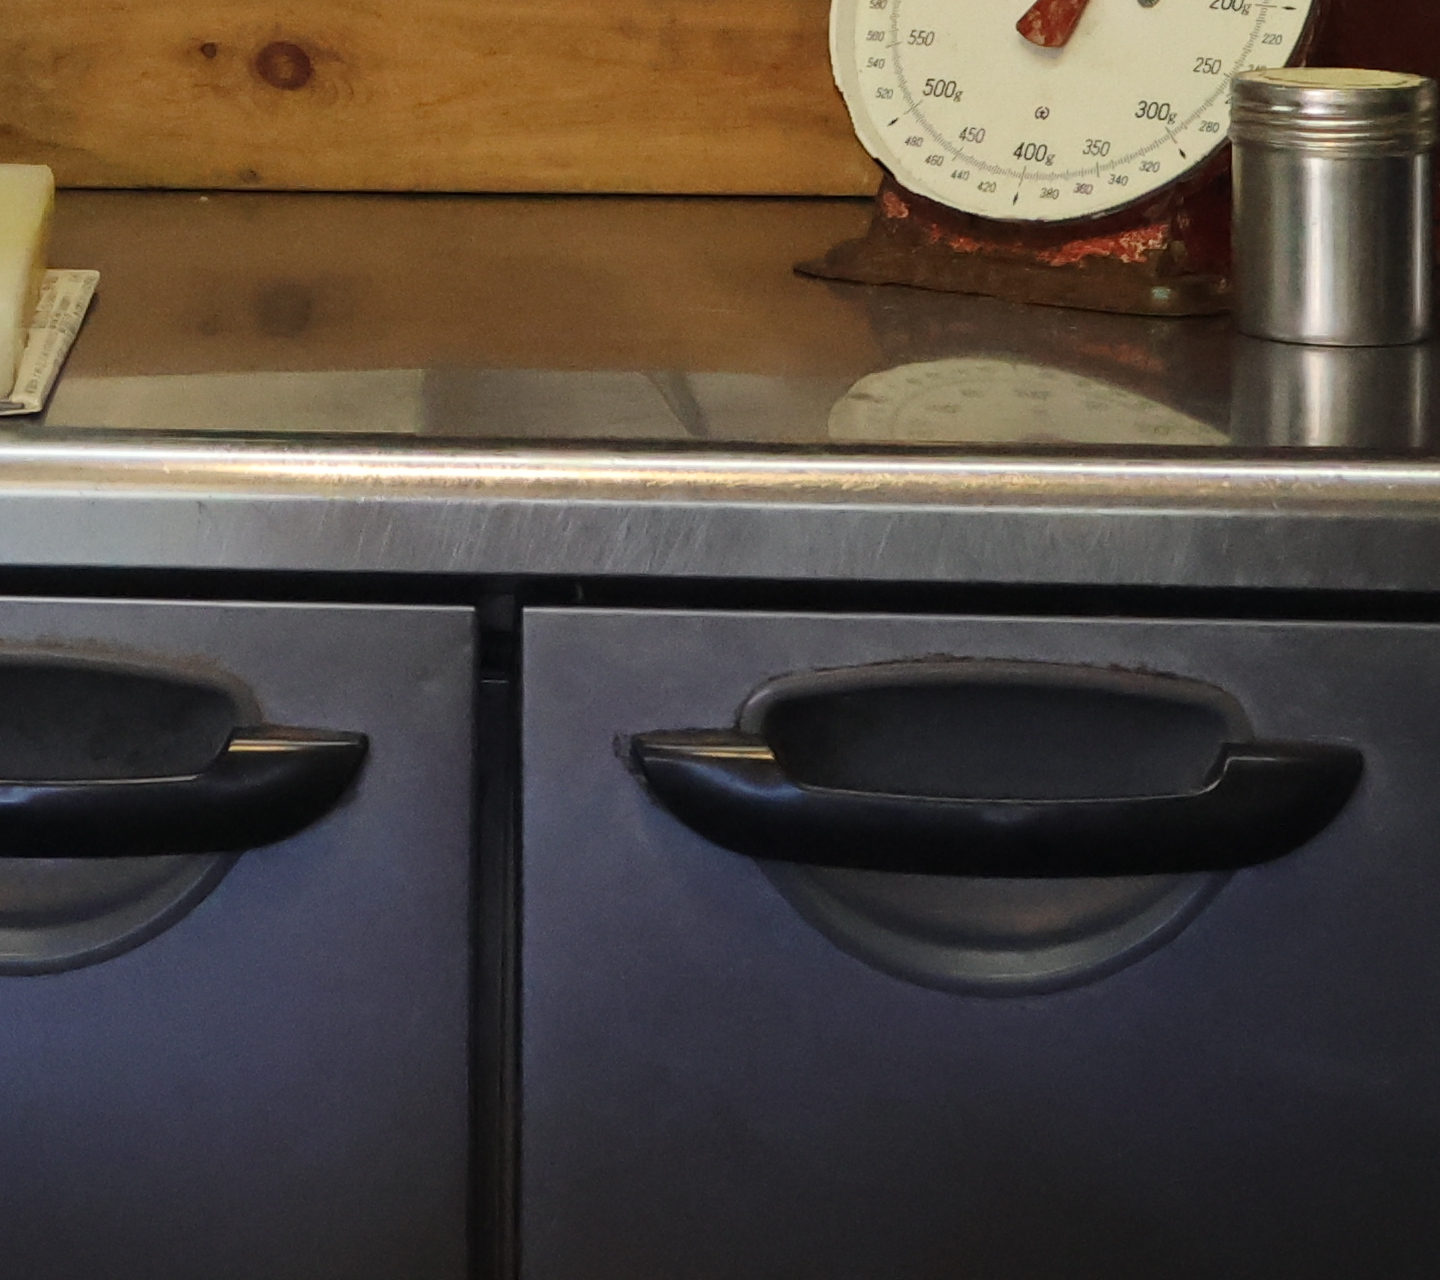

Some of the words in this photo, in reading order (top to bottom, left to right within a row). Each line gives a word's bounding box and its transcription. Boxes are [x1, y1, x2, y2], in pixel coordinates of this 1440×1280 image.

[907, 29, 935, 47] 550
[1261, 32, 1283, 46] 220
[866, 57, 886, 69] 540
[1193, 56, 1222, 75] 250
[875, 87, 894, 99] 520
[922, 77, 964, 103] 500g
[1134, 99, 1178, 126] 300g
[1198, 120, 1220, 134] 280
[904, 135, 924, 147] 480
[958, 126, 986, 144] 450
[1013, 141, 1056, 166] 400g
[1082, 138, 1111, 157] 350
[924, 154, 945, 167] 460
[1138, 160, 1161, 173] 320
[950, 169, 971, 181] 440
[1108, 173, 1129, 187] 340
[976, 181, 997, 193] 420
[1039, 187, 1060, 200] 380
